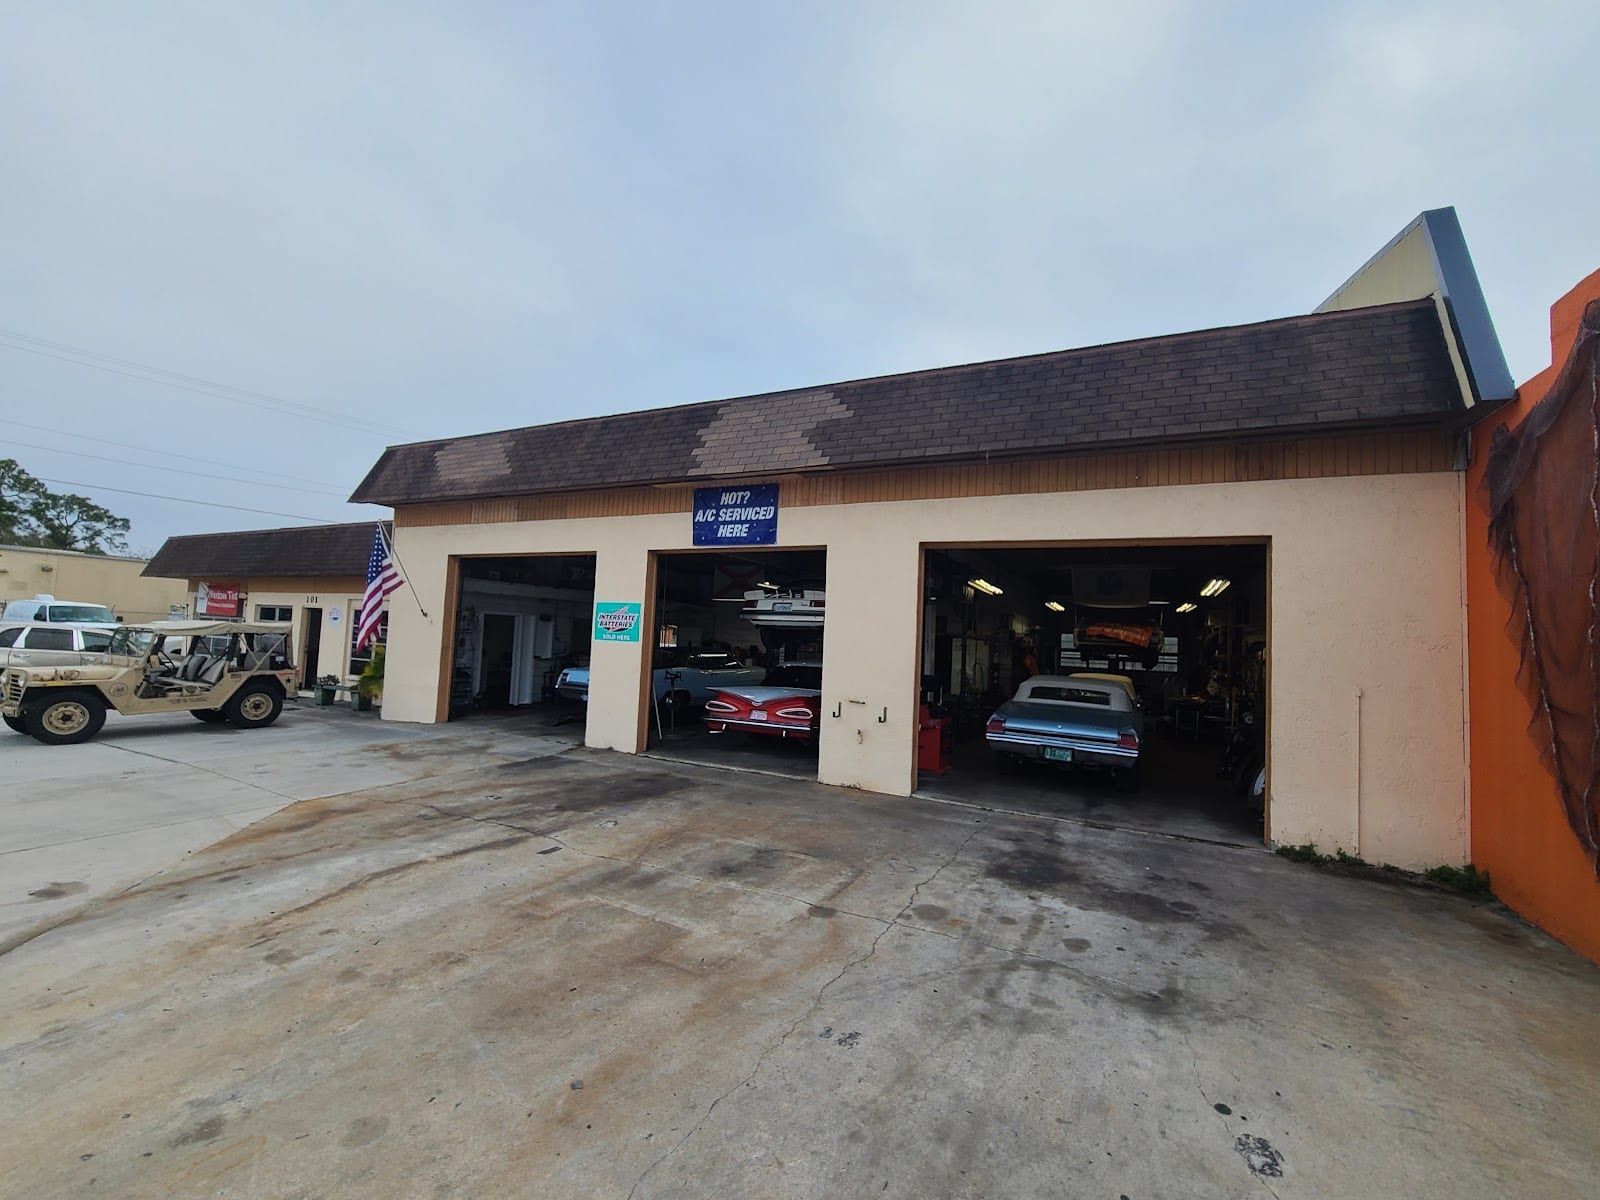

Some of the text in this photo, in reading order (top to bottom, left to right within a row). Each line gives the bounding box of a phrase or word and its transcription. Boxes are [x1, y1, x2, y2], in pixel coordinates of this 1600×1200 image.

[720, 491, 751, 506] HOT?
[694, 506, 775, 522] A/C SERVICED
[717, 524, 750, 537] HERE
[306, 595, 318, 603] 101
